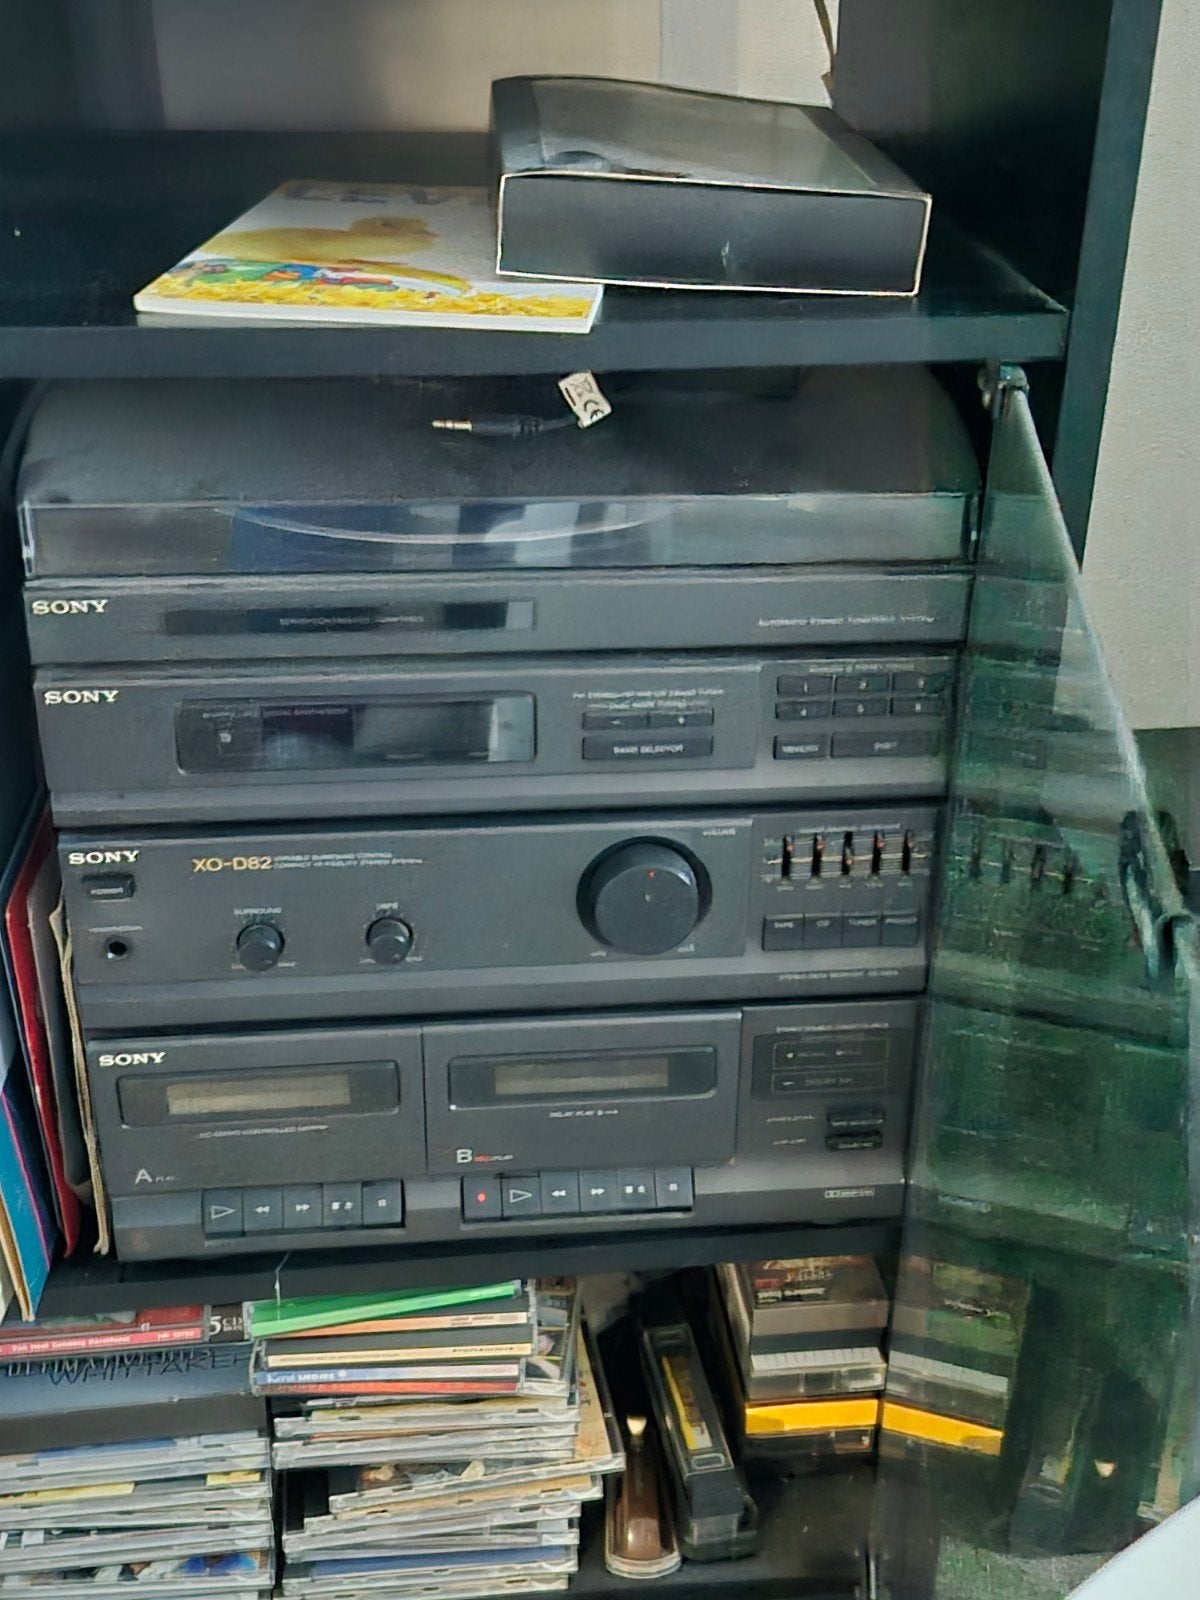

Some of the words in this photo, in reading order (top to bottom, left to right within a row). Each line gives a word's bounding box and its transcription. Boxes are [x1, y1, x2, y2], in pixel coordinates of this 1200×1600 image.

[32, 599, 109, 615] SONY
[44, 690, 119, 705] SONY
[68, 850, 140, 865] SONY
[191, 855, 273, 873] XO-D82
[98, 1051, 166, 1067] SONY
[456, 1149, 473, 1164] B
[134, 1168, 153, 1185] A
[207, 1315, 222, 1336] 5
